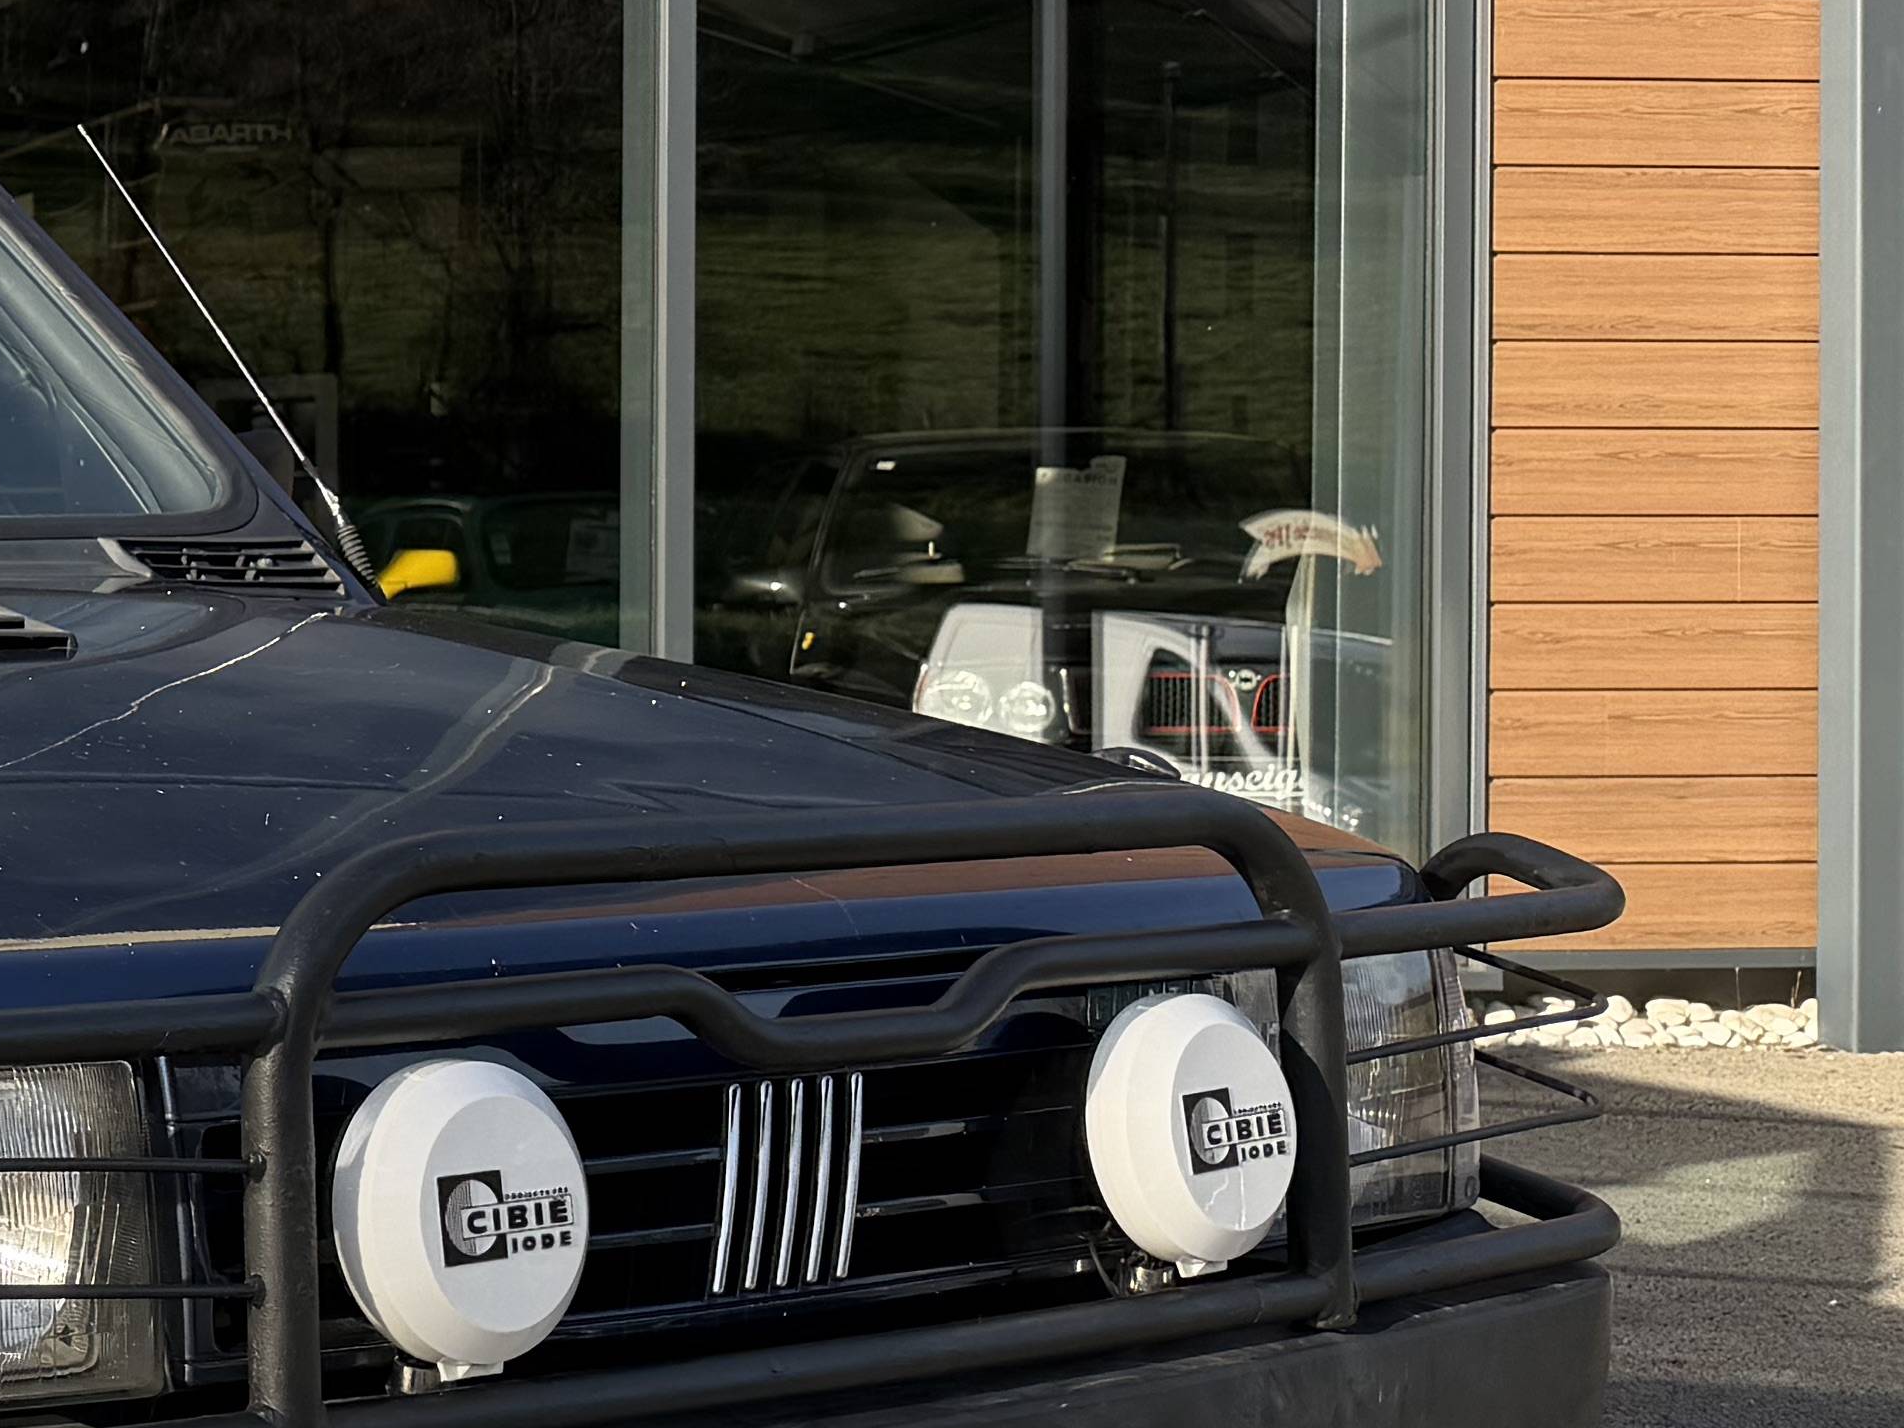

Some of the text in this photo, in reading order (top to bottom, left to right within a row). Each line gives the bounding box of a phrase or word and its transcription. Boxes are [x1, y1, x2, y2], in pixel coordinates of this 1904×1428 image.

[169, 123, 291, 145] ABARTH
[1241, 1140, 1287, 1162] IODE
[512, 1230, 572, 1254] IODE
